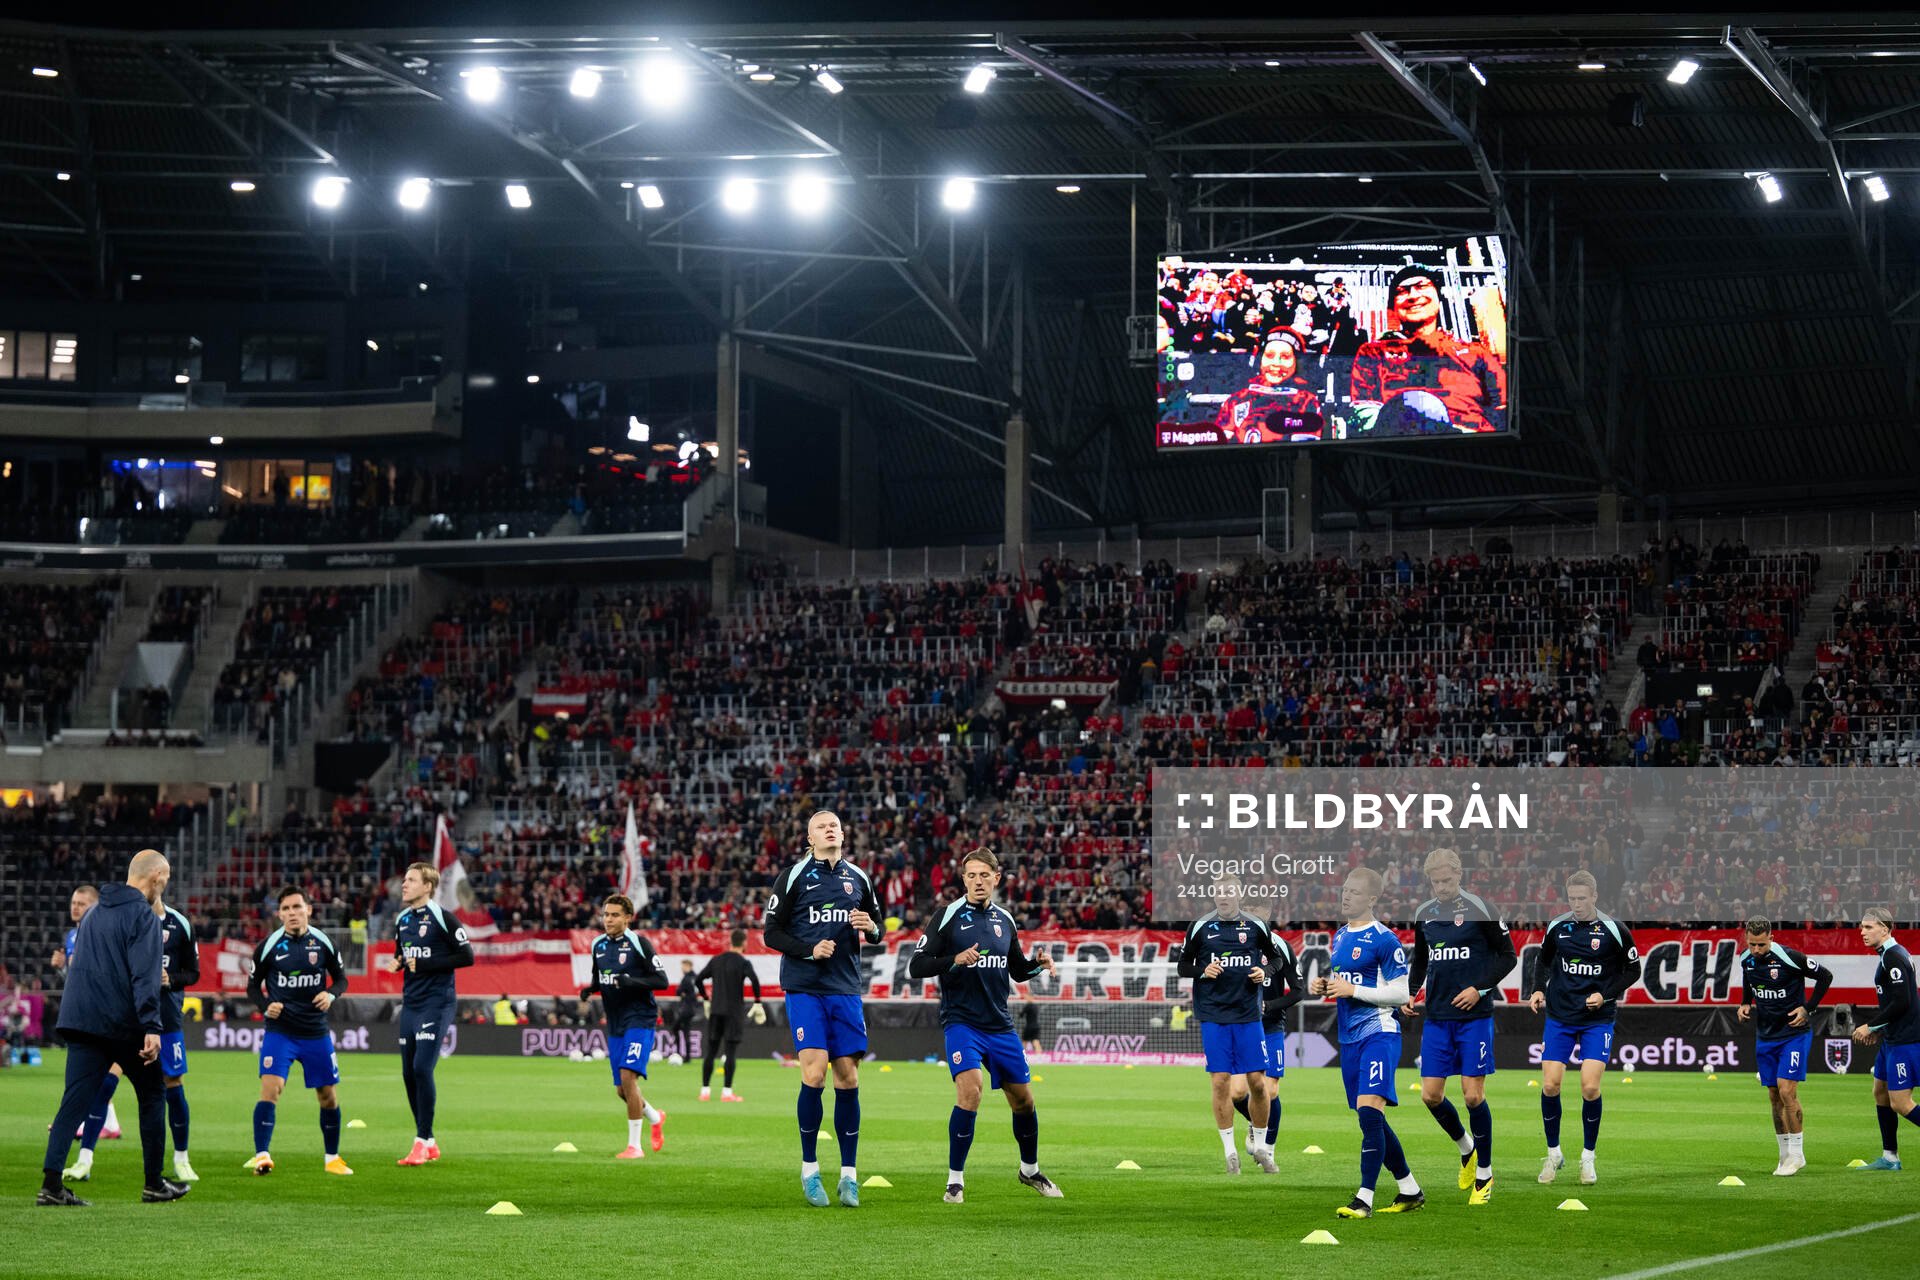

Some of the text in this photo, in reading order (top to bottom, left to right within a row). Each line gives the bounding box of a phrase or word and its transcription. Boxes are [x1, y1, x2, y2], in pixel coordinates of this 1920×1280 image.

[1172, 431, 1218, 445] Magenta
[1562, 957, 1602, 976] bama
[278, 971, 321, 988] bama
[522, 1029, 609, 1056] PUMA
[1054, 1034, 1145, 1053] AWAY
[1479, 1041, 1487, 1060] 2
[1528, 1037, 1740, 1065] s.oefb.at
[1369, 1061, 1384, 1081] 21
